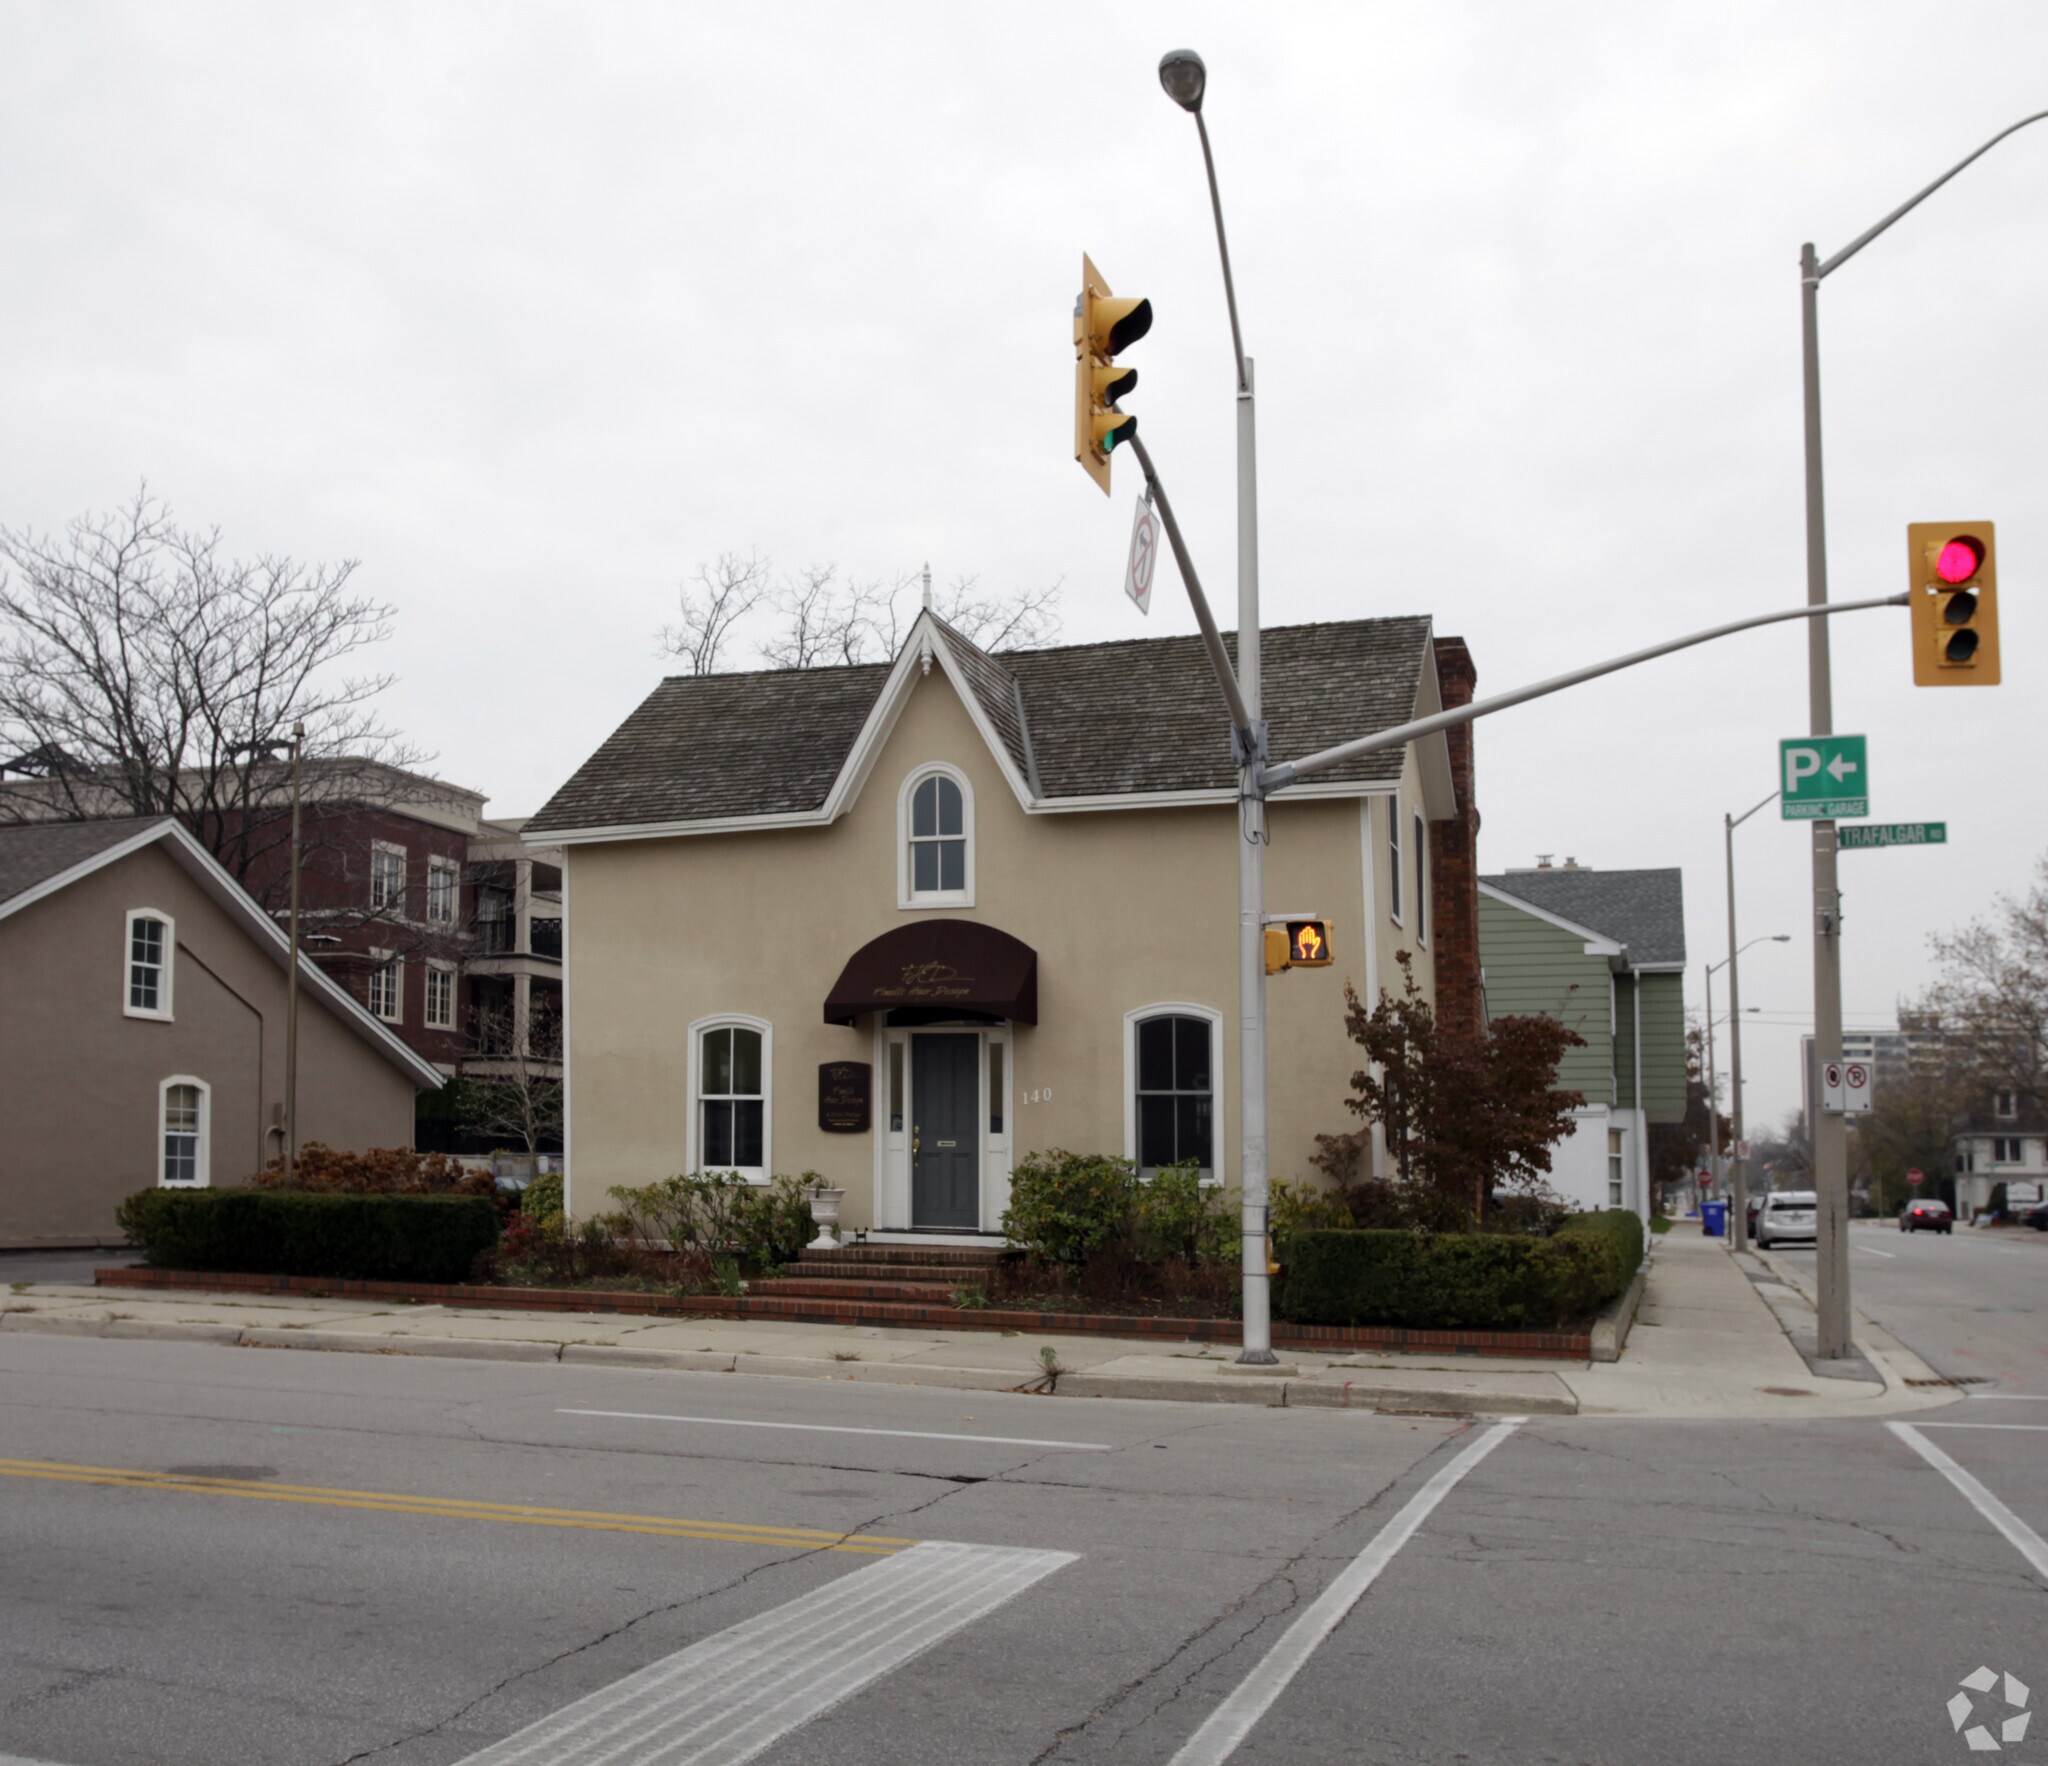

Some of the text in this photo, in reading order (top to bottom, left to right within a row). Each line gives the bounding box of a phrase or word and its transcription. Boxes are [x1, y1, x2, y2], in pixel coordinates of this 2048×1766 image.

[1785, 747, 1822, 793] P
[1785, 801, 1865, 817] PARKING GARAGE
[1842, 824, 1926, 845] TRAFALGAR
[1022, 1087, 1052, 1105] 140
